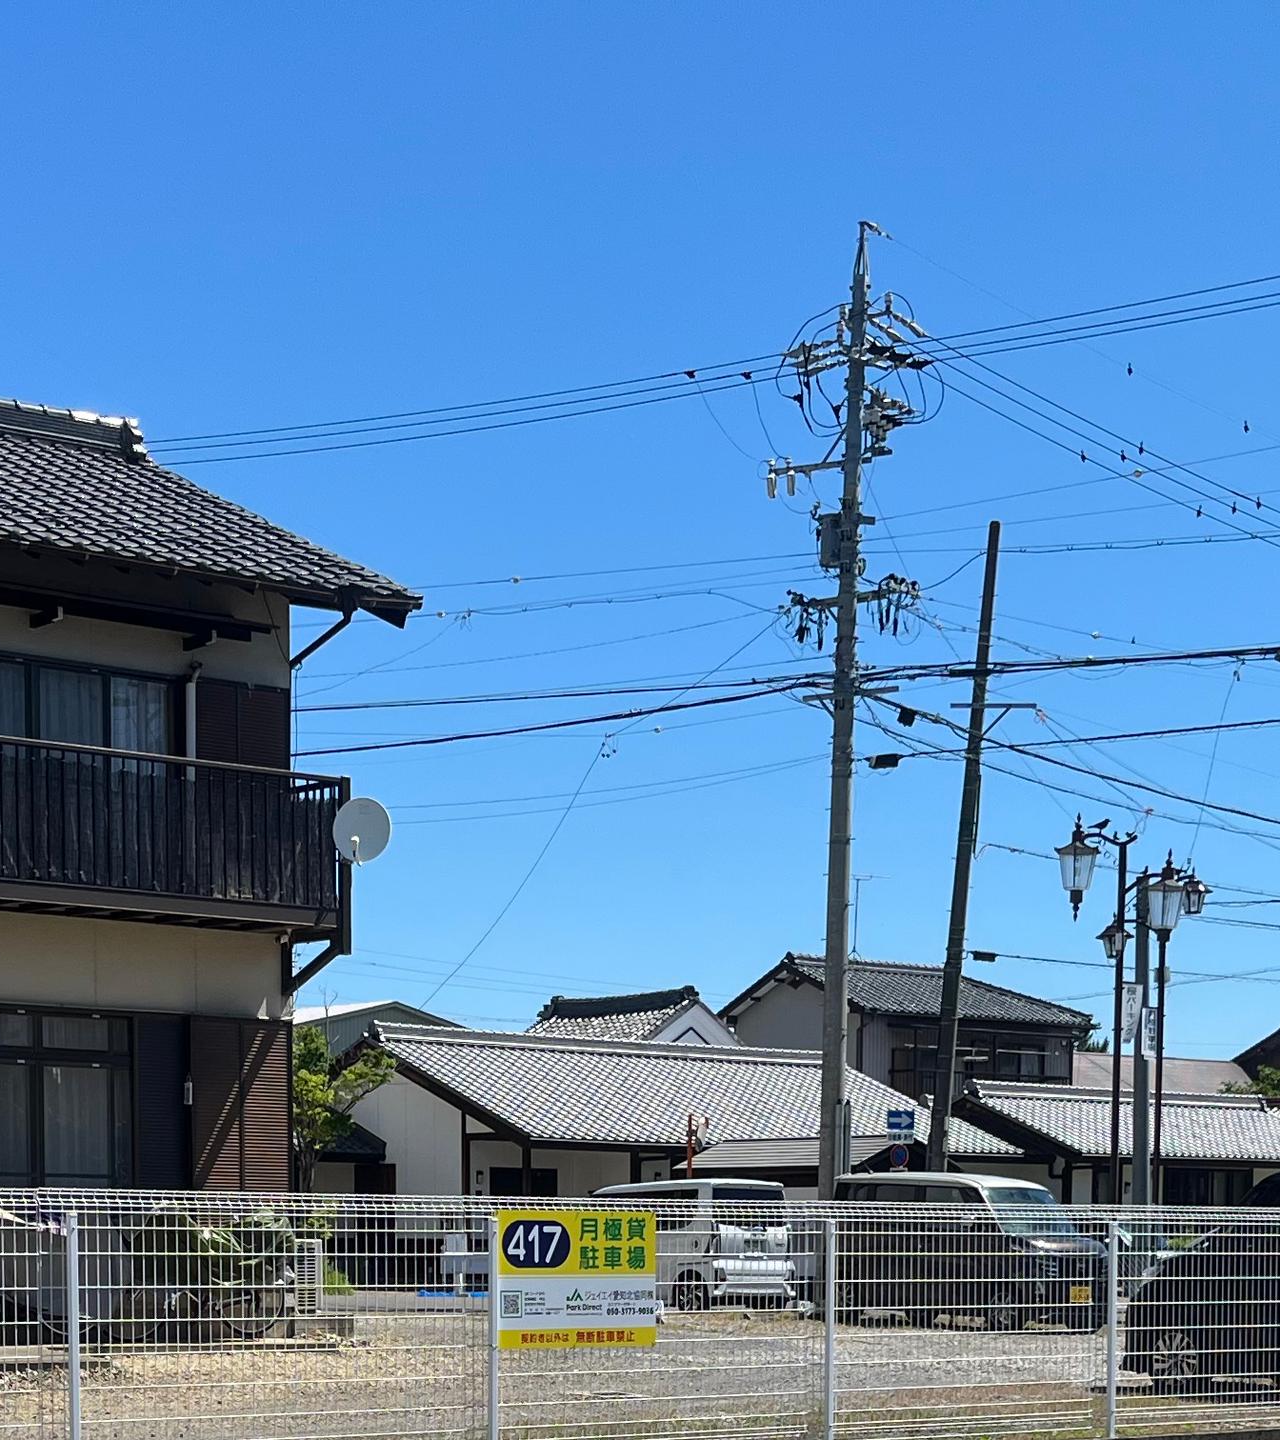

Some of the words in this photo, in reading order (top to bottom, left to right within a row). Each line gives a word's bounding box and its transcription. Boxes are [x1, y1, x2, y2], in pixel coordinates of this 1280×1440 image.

[579, 1218, 646, 1242] 月極貸
[507, 1224, 562, 1264] 417
[579, 1245, 646, 1270] 駐車場
[582, 1303, 603, 1311] Direct
